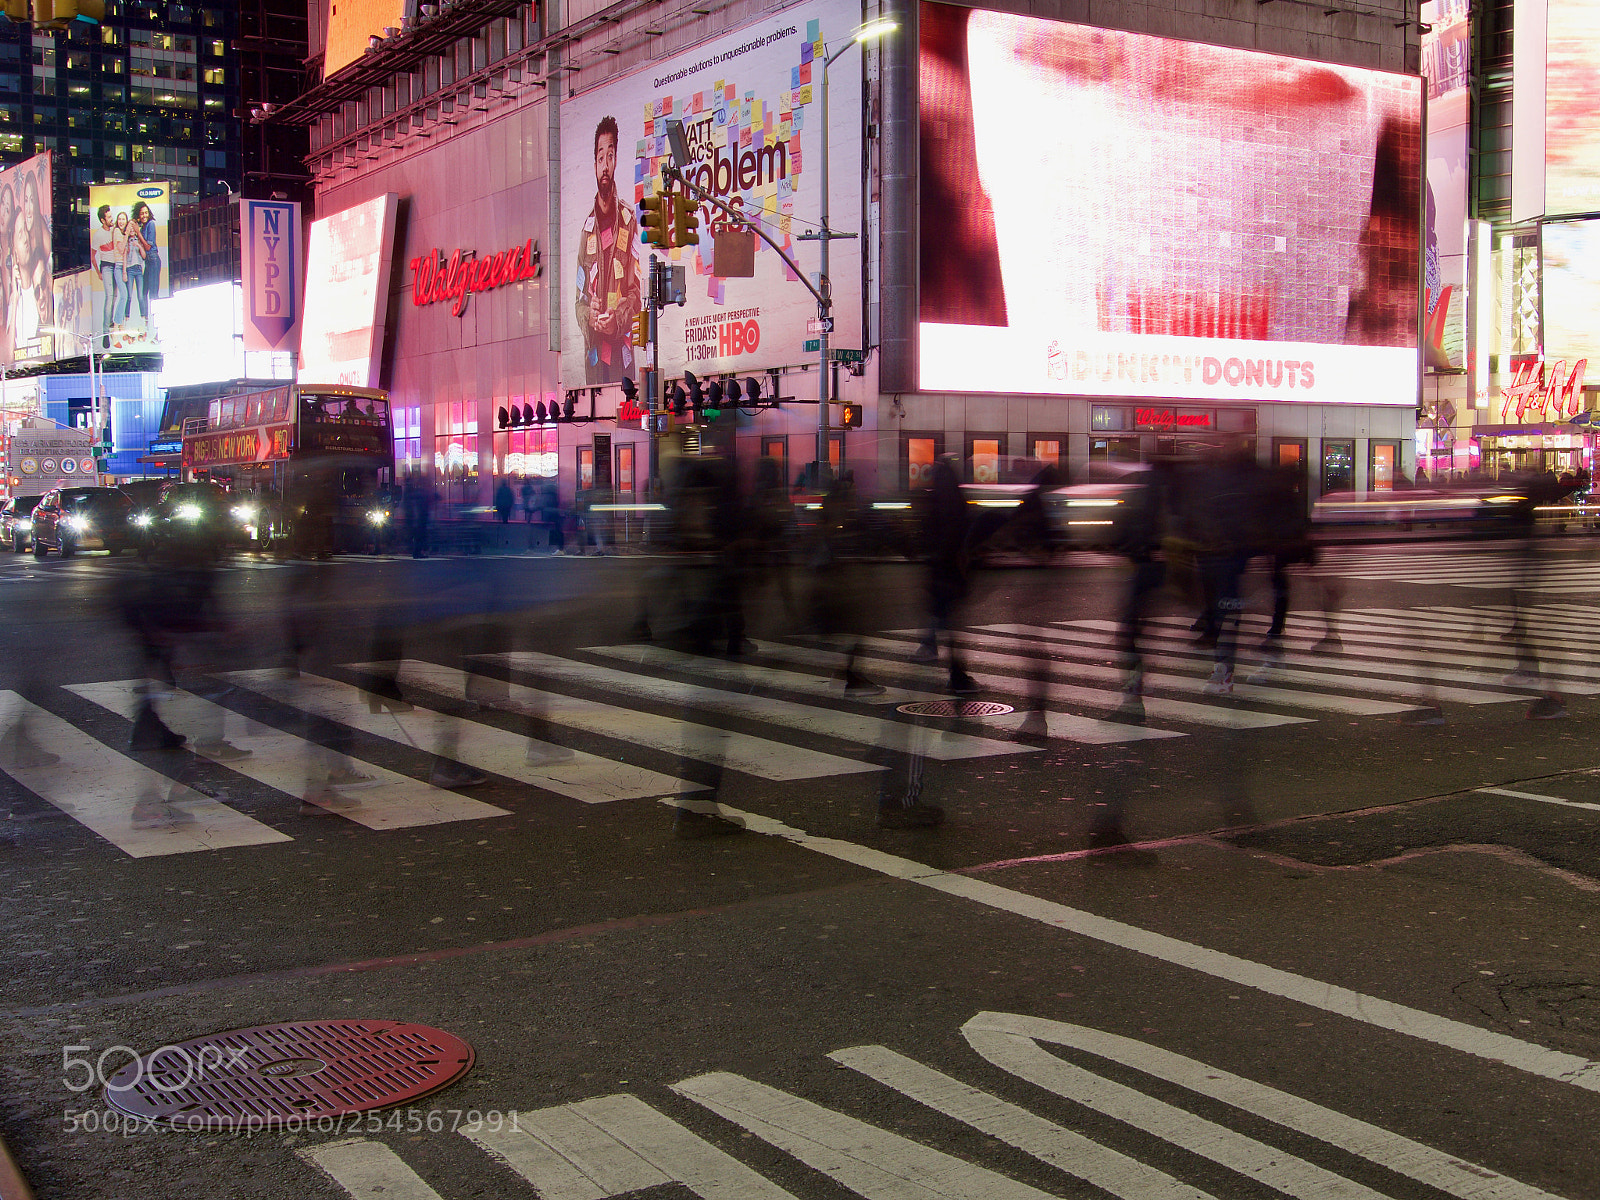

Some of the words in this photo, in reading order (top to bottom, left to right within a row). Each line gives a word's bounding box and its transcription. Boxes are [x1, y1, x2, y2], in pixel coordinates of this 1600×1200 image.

[653, 68, 688, 88] Questionable
[688, 58, 713, 75] solutions
[713, 55, 720, 65] to
[720, 36, 766, 62] unquestionable
[766, 25, 798, 47] problems.
[685, 117, 714, 146] ATT
[668, 142, 713, 170] CAC'S
[262, 209, 281, 315] NYPD
[410, 238, 537, 317] Walgreens
[685, 319, 688, 327] A
[689, 317, 700, 327] NEW
[700, 315, 712, 325] LATE
[712, 312, 727, 323] NIGHT
[727, 307, 760, 321] PERSPECTIVE
[685, 325, 717, 343] FRIDAYS
[719, 319, 760, 357] HBO
[809, 341, 813, 351] 7
[686, 344, 718, 361] 11:30PM
[837, 351, 844, 360] W
[845, 351, 854, 360] 42
[1202, 356, 1315, 389] DONUTS
[1501, 358, 1588, 419] H&M
[219, 436, 236, 459] NEW
[236, 434, 256, 457] YORK
